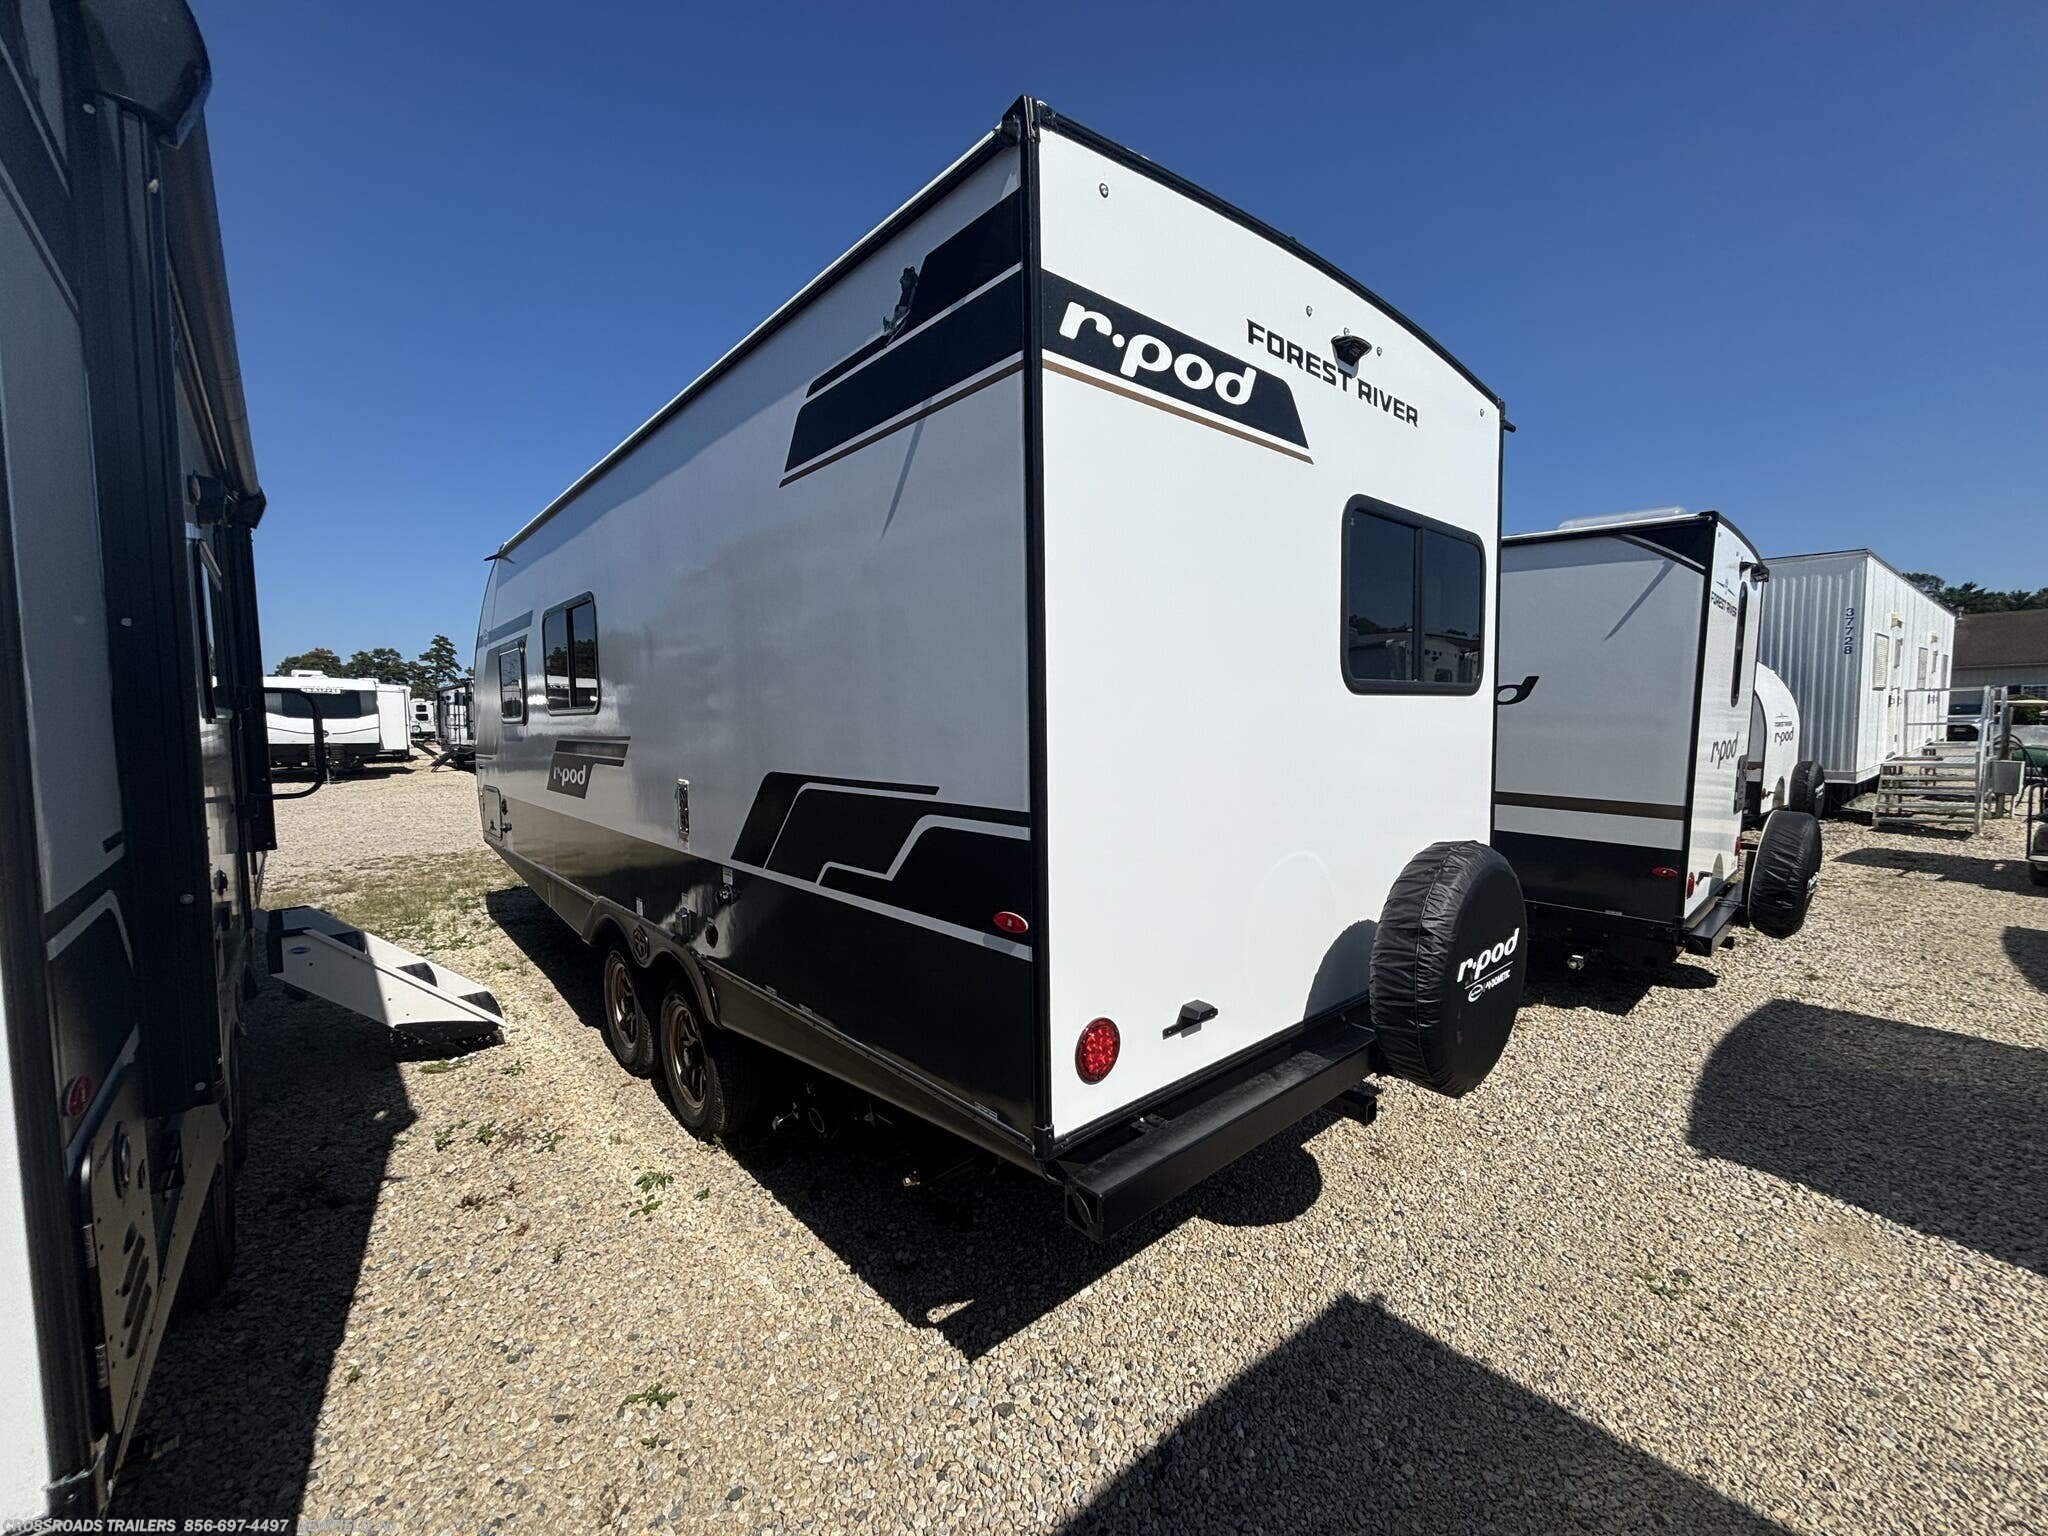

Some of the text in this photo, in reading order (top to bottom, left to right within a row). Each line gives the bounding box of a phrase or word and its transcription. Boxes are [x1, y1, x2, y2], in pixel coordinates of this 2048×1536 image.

[1247, 318, 1419, 428] FOREST RIVER
[1843, 607, 1855, 655] 37728
